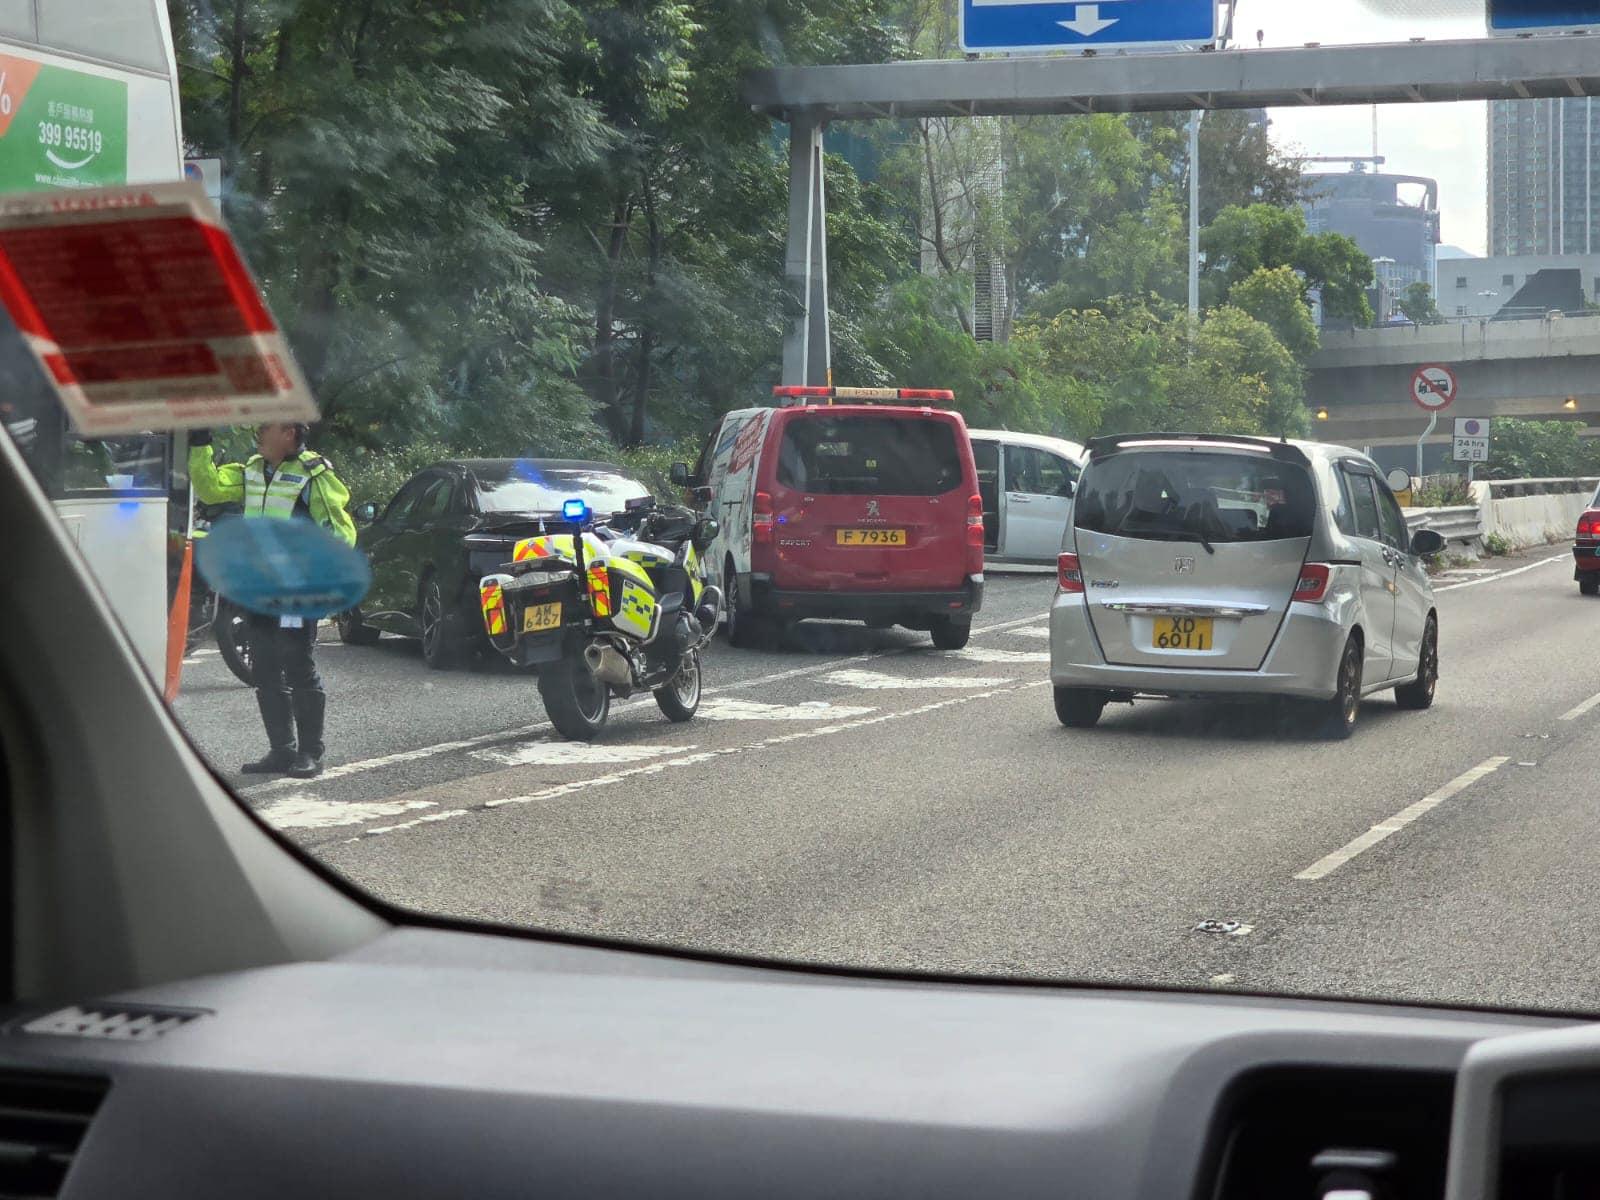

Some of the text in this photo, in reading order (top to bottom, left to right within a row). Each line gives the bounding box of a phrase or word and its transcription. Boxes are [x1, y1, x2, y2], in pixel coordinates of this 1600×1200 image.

[38, 121, 102, 154] 399 95519
[1457, 439, 1470, 447] 24
[844, 531, 898, 543] F 7936
[535, 604, 552, 617] AM
[526, 613, 559, 629] 6467
[1171, 616, 1195, 633] XD
[1158, 632, 1203, 650] 6011
